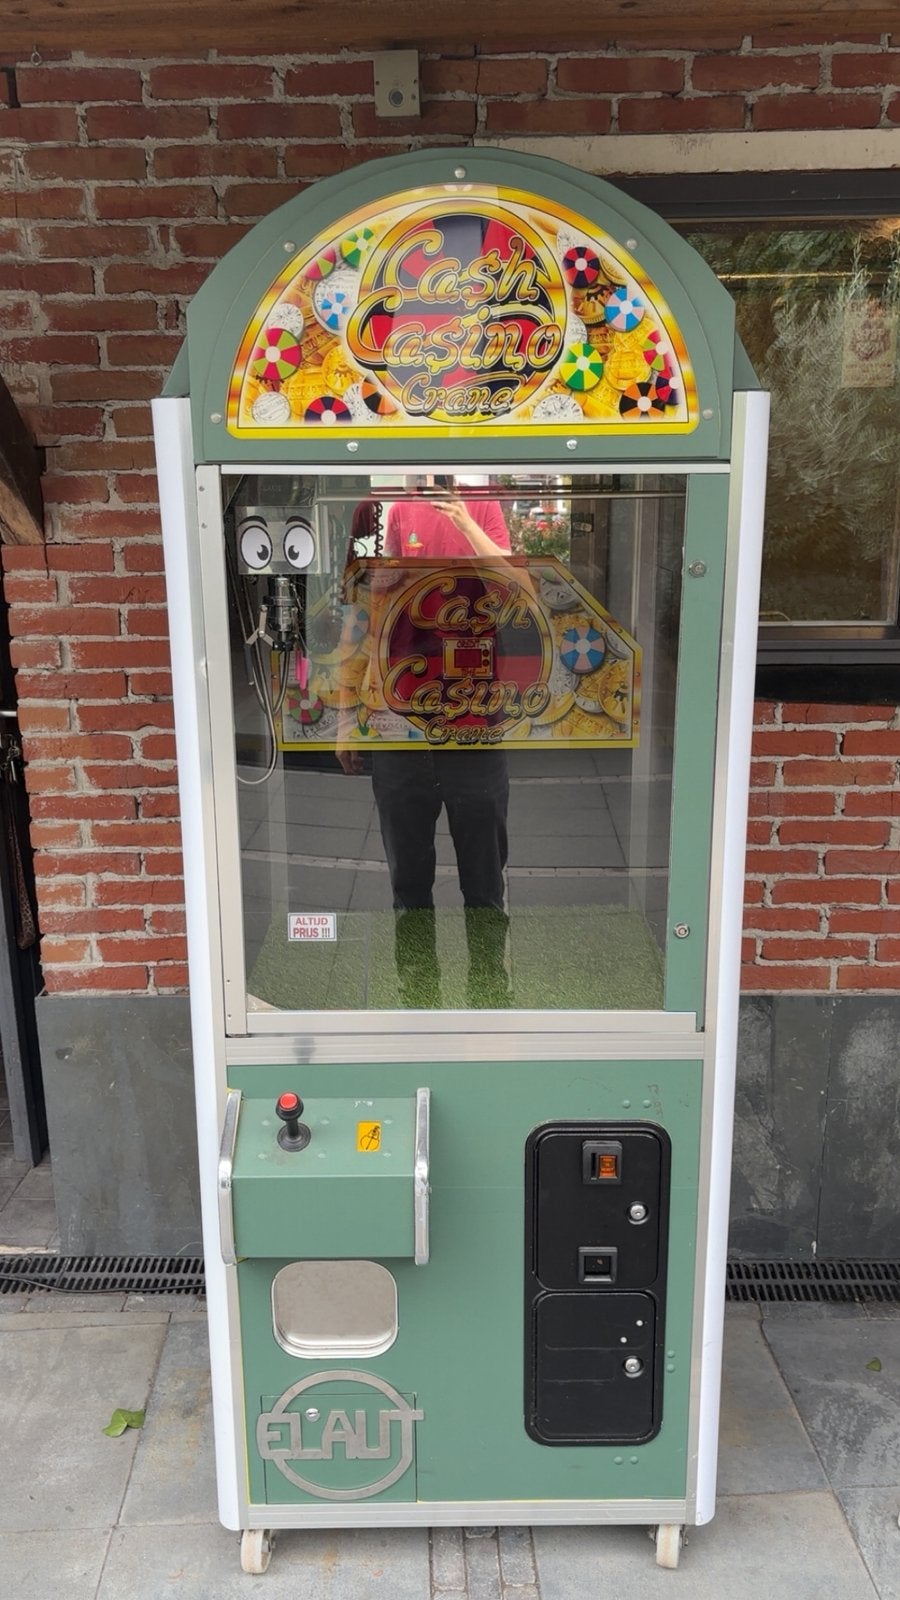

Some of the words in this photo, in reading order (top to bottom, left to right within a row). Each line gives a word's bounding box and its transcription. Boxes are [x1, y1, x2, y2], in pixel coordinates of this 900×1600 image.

[383, 229, 541, 307] Cash
[346, 286, 563, 374] Casino
[401, 372, 520, 415] Crane
[409, 575, 532, 635] Cash
[383, 654, 551, 720] Casino
[425, 715, 505, 744] Crane
[293, 927, 320, 938] PRIJS
[256, 1409, 424, 1460] ELAUT
